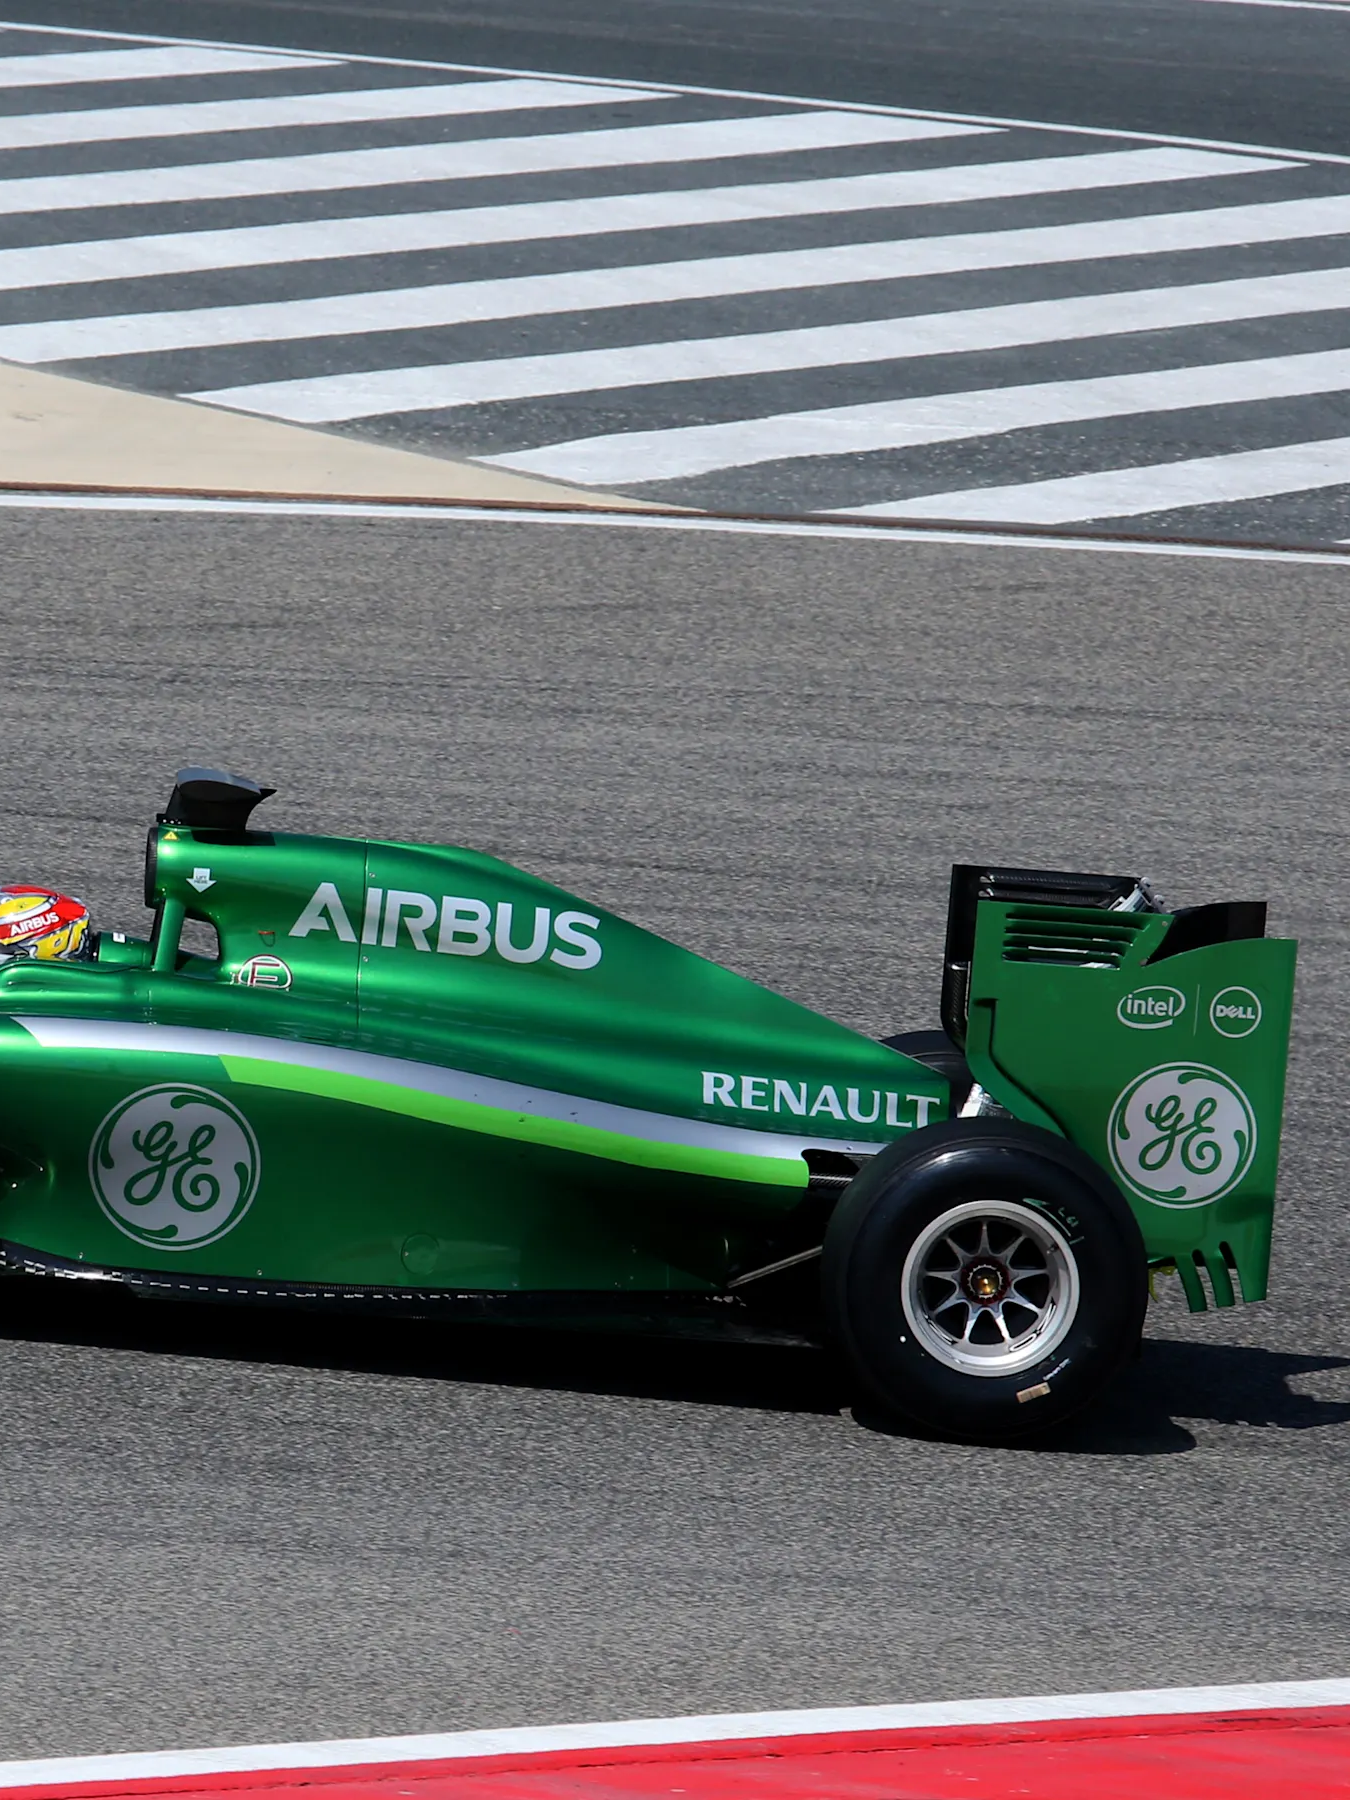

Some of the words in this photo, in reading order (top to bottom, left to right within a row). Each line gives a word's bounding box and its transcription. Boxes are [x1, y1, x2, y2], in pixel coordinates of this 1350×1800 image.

[10, 911, 60, 937] AIRBUS
[288, 881, 603, 970] AIRBUS
[1126, 993, 1176, 1017] intel
[1215, 1004, 1256, 1020] DELL
[701, 1071, 941, 1129] RENAULT
[1138, 1094, 1222, 1175] GE
[123, 1120, 221, 1213] GE
